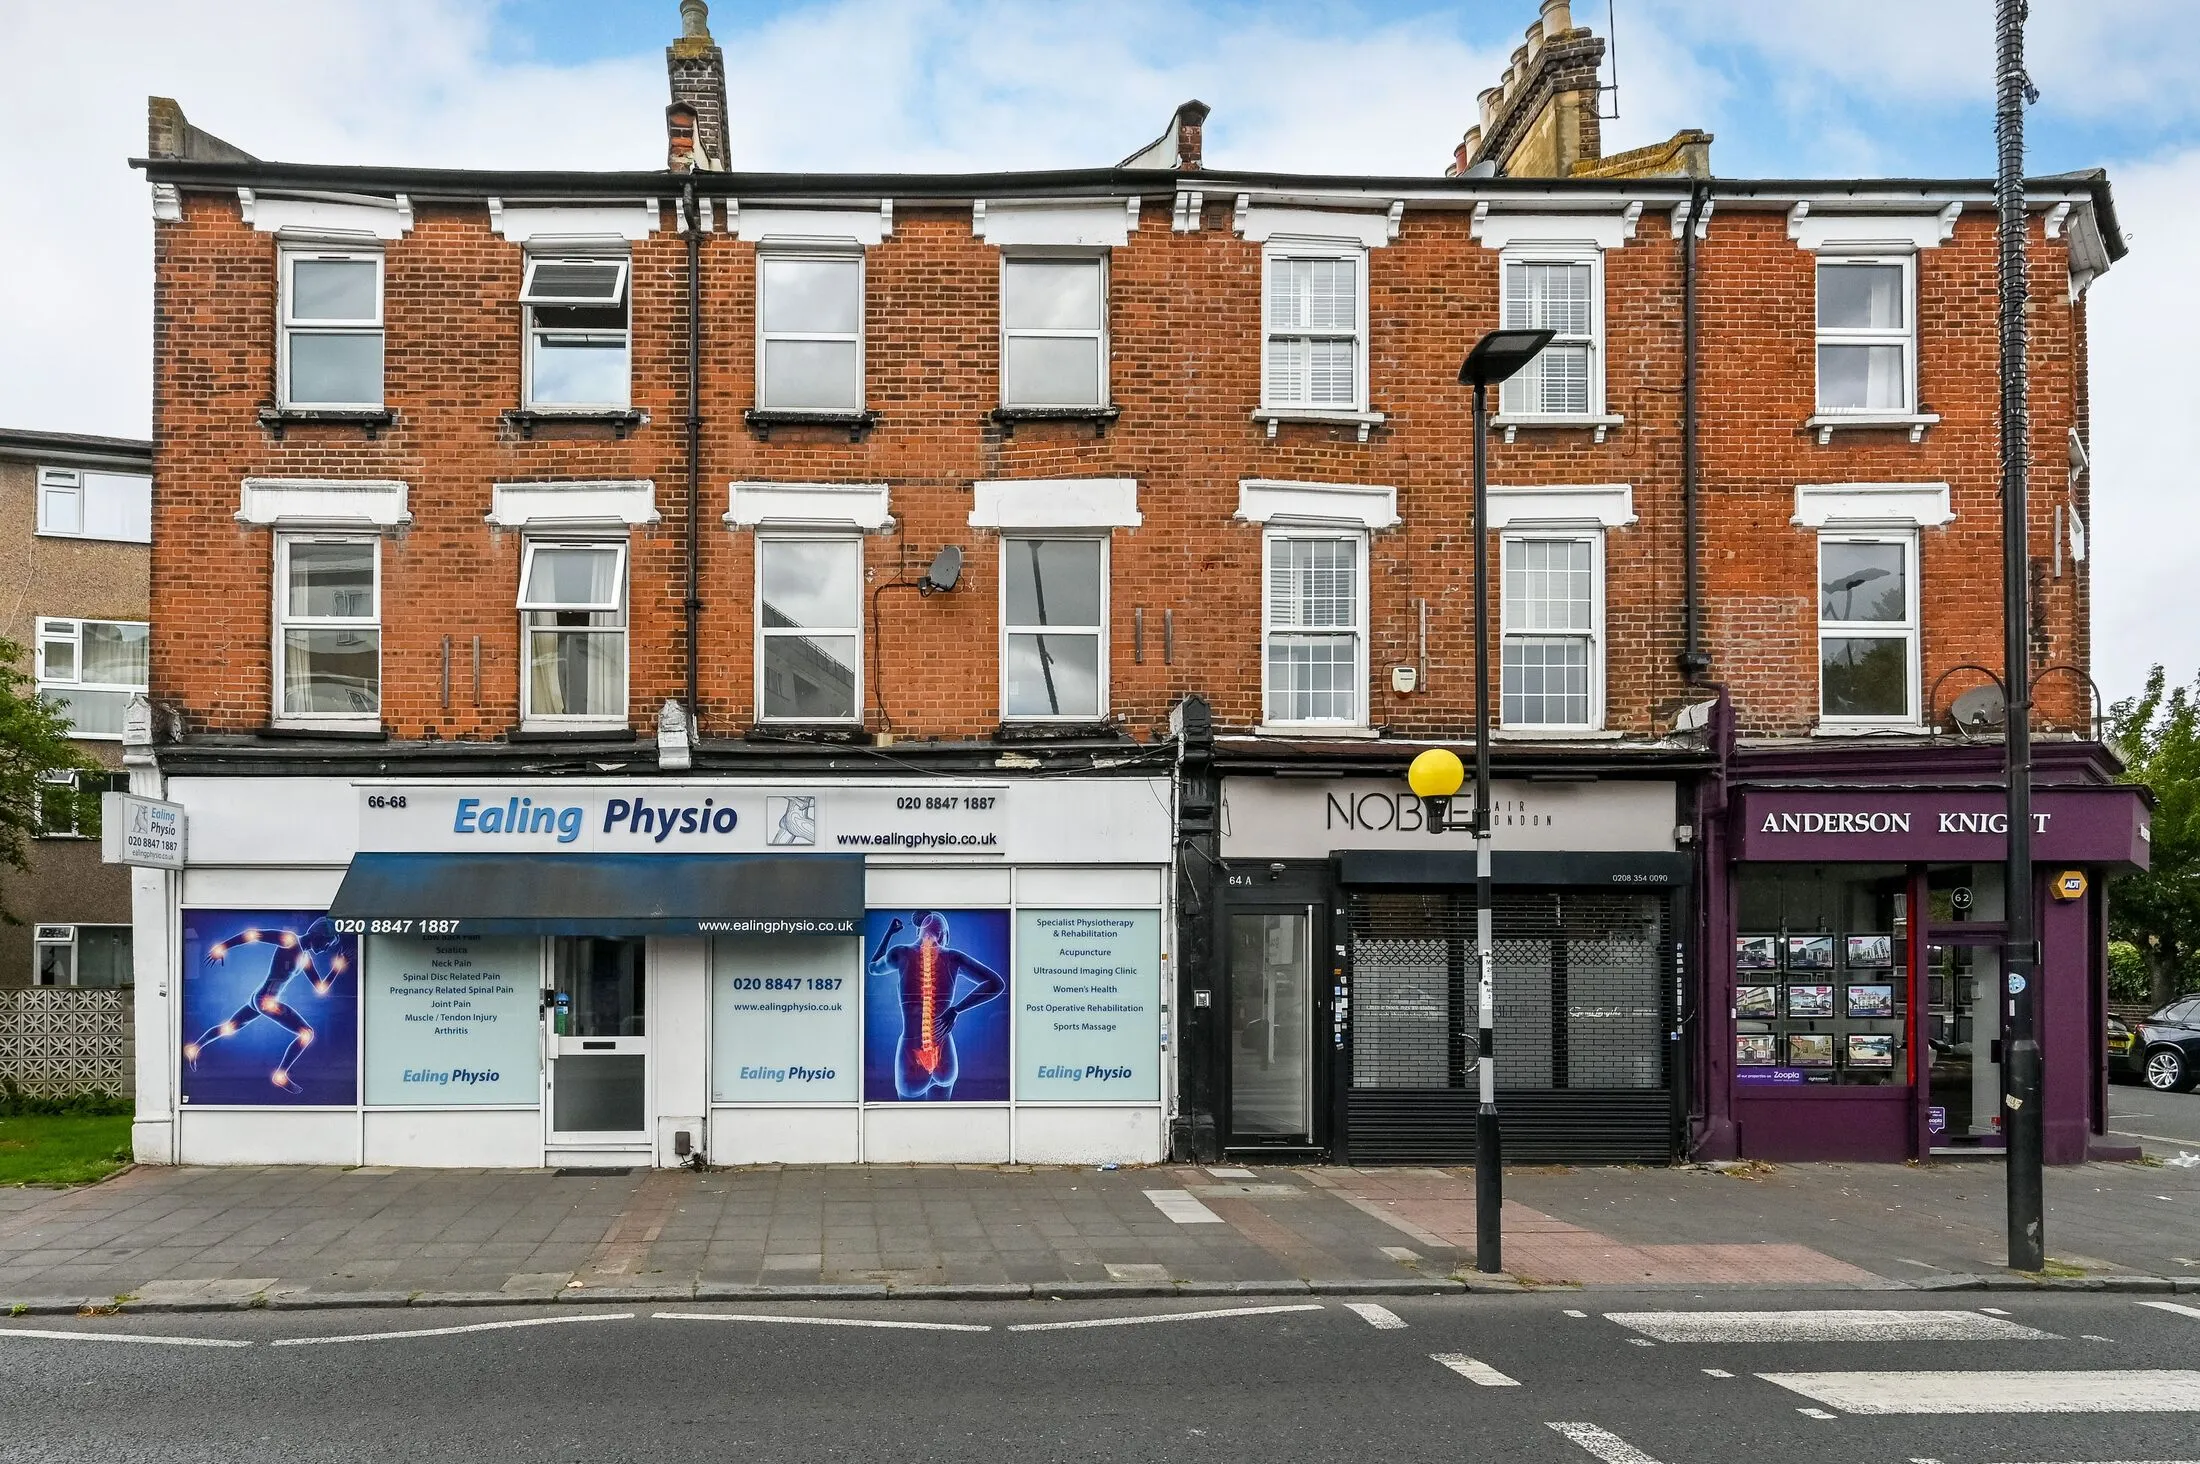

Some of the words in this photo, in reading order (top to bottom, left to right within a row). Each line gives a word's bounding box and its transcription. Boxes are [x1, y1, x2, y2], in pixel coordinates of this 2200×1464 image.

[368, 796, 407, 809] 66-68
[897, 797, 922, 810] 020
[925, 797, 959, 810] 8847
[964, 797, 996, 810] 1887
[1494, 801, 1525, 812] AIR
[151, 808, 175, 824] Ealing
[454, 797, 583, 843] Ealing
[602, 797, 738, 843] Physio
[1494, 814, 1552, 826] ONDON
[1760, 813, 1912, 832] ANDERSON
[1939, 813, 2051, 833] KNIGT
[151, 822, 176, 837] Physio
[128, 836, 142, 846] 020
[143, 838, 160, 849] 8847
[162, 840, 178, 851] 1887
[837, 832, 998, 849] www.ealingphysio.co.uk
[1229, 875, 1242, 885] 64
[1245, 876, 1252, 886] A
[1612, 874, 1631, 882] 0208
[1633, 874, 1647, 882] 354
[1649, 874, 1668, 882] 0090
[2064, 879, 2081, 889] ADT
[334, 920, 366, 933] 020
[370, 920, 413, 933] 8847
[418, 920, 460, 933] 1887
[697, 919, 854, 933] www.ealingphysio.co.uk
[1037, 919, 1075, 928] Specialist
[1077, 919, 1135, 928] Physiotherapy
[1053, 930, 1060, 938] &
[1062, 929, 1118, 938] Rehabilitation
[435, 946, 468, 954] Sciatica
[1060, 948, 1112, 958] Acupuncture
[431, 959, 451, 967] Neck
[453, 959, 472, 967] Pain
[403, 972, 429, 982] Spinal
[430, 972, 448, 980] Disc
[450, 972, 481, 980] Related
[483, 972, 501, 980] Pain
[1033, 966, 1077, 975] Ultrasound
[1079, 966, 1113, 977] Imaging
[1115, 966, 1137, 975] Clinic
[734, 978, 762, 990] 020
[765, 978, 802, 990] 8847
[807, 978, 843, 990] 1887
[1053, 985, 1089, 994] Women's
[1091, 985, 1118, 994] Health
[389, 986, 433, 996] Pregnancy
[435, 986, 466, 994] Related
[468, 986, 494, 995] Spinal
[497, 986, 514, 994] Pain
[431, 1000, 451, 1008] Joint
[453, 1000, 471, 1008] Pain
[734, 1002, 843, 1013] www.ealingphysio.co.uk
[1027, 1004, 1044, 1012] Post
[1046, 1004, 1086, 1014] Operative
[1088, 1004, 1144, 1012] Rehabilitation
[405, 1013, 434, 1022] Muscle
[441, 1013, 472, 1022] Tendon
[474, 1013, 498, 1023] Injury
[434, 1026, 469, 1035] Arthritis
[1053, 1022, 1080, 1032] Sports
[1082, 1022, 1117, 1033] Massage
[402, 1068, 449, 1086] Ealing
[451, 1068, 500, 1086] Physio
[740, 1066, 786, 1083] Ealing
[788, 1066, 836, 1083] Physio
[1037, 1065, 1083, 1082] Ealing
[1085, 1065, 1132, 1082] Physio
[1774, 1071, 1800, 1080] Zoopla
